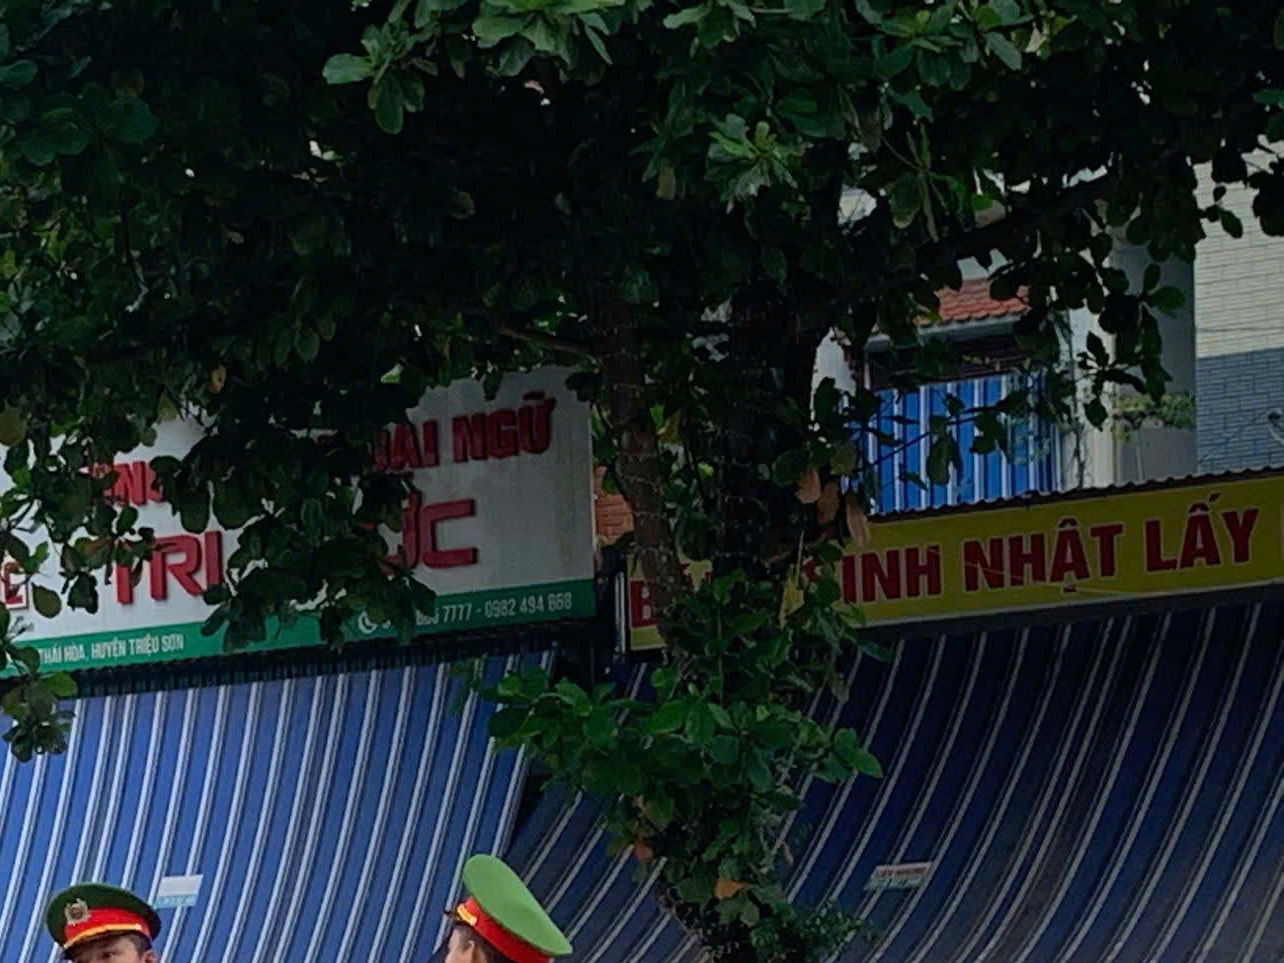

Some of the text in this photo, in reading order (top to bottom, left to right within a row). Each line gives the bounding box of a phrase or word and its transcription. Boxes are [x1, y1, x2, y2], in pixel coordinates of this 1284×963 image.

[452, 391, 555, 463] NGỮ
[964, 518, 1123, 593] NHẬT
[1145, 492, 1260, 573] LẤY
